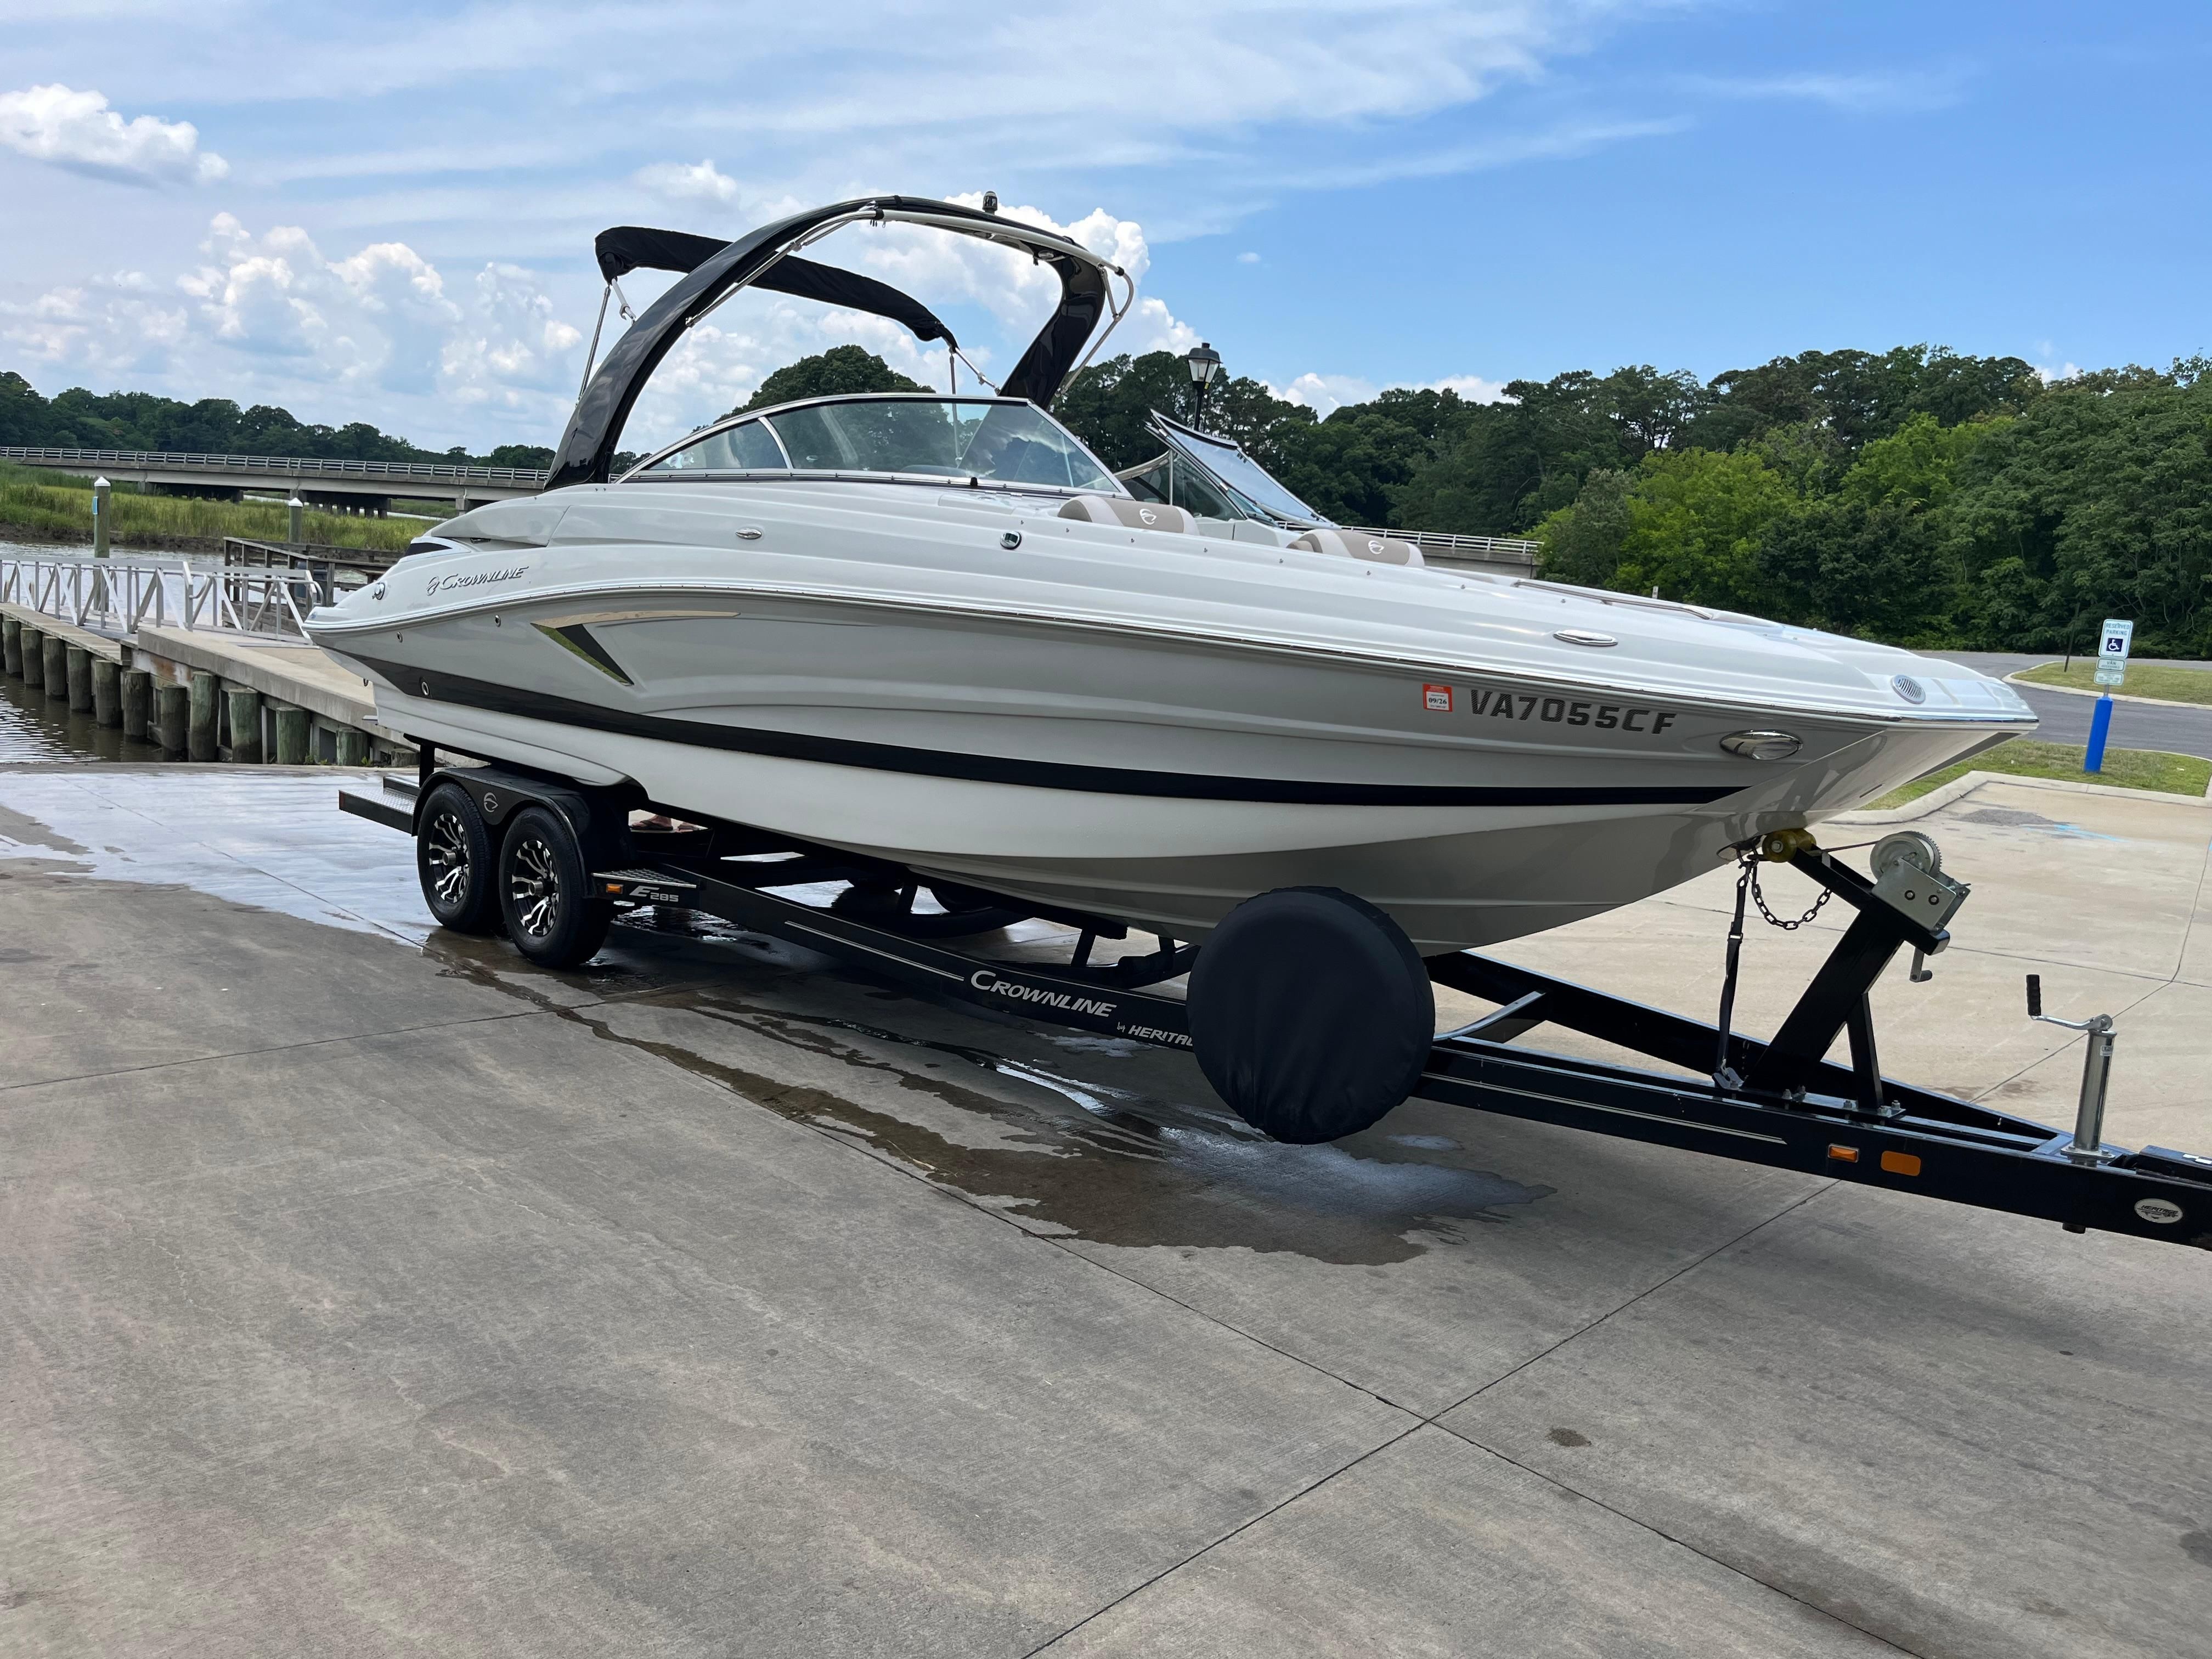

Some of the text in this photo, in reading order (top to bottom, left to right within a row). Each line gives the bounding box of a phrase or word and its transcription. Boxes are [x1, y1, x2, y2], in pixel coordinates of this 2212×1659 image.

[439, 566, 529, 590] CROWNLINE
[1471, 689, 1677, 735] VA7055CF
[970, 970, 1118, 1018] CROWNLINE
[1116, 1021, 1126, 1032] by
